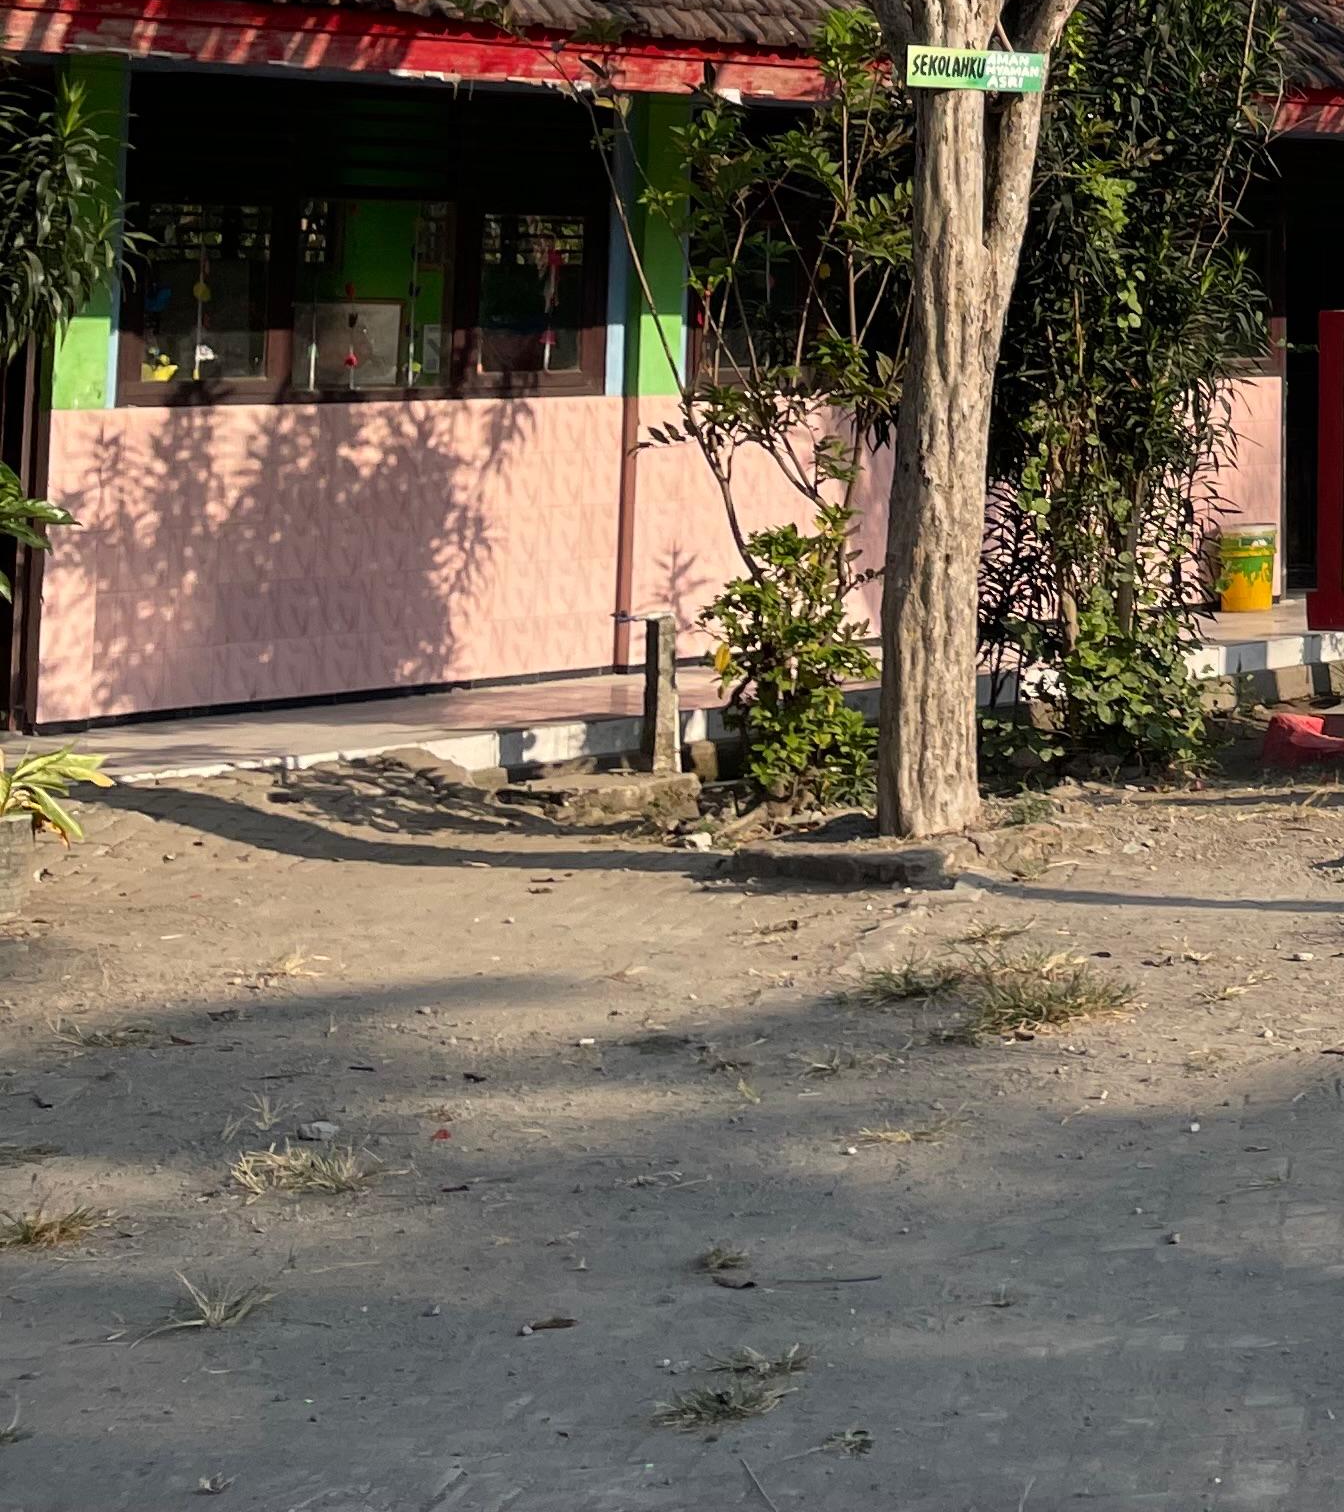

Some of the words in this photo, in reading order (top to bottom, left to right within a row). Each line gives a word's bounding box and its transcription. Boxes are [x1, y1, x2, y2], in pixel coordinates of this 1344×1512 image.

[986, 53, 1030, 66] AMAN
[912, 54, 987, 79] SEKOLAHKU
[987, 76, 1023, 88] ASRI
